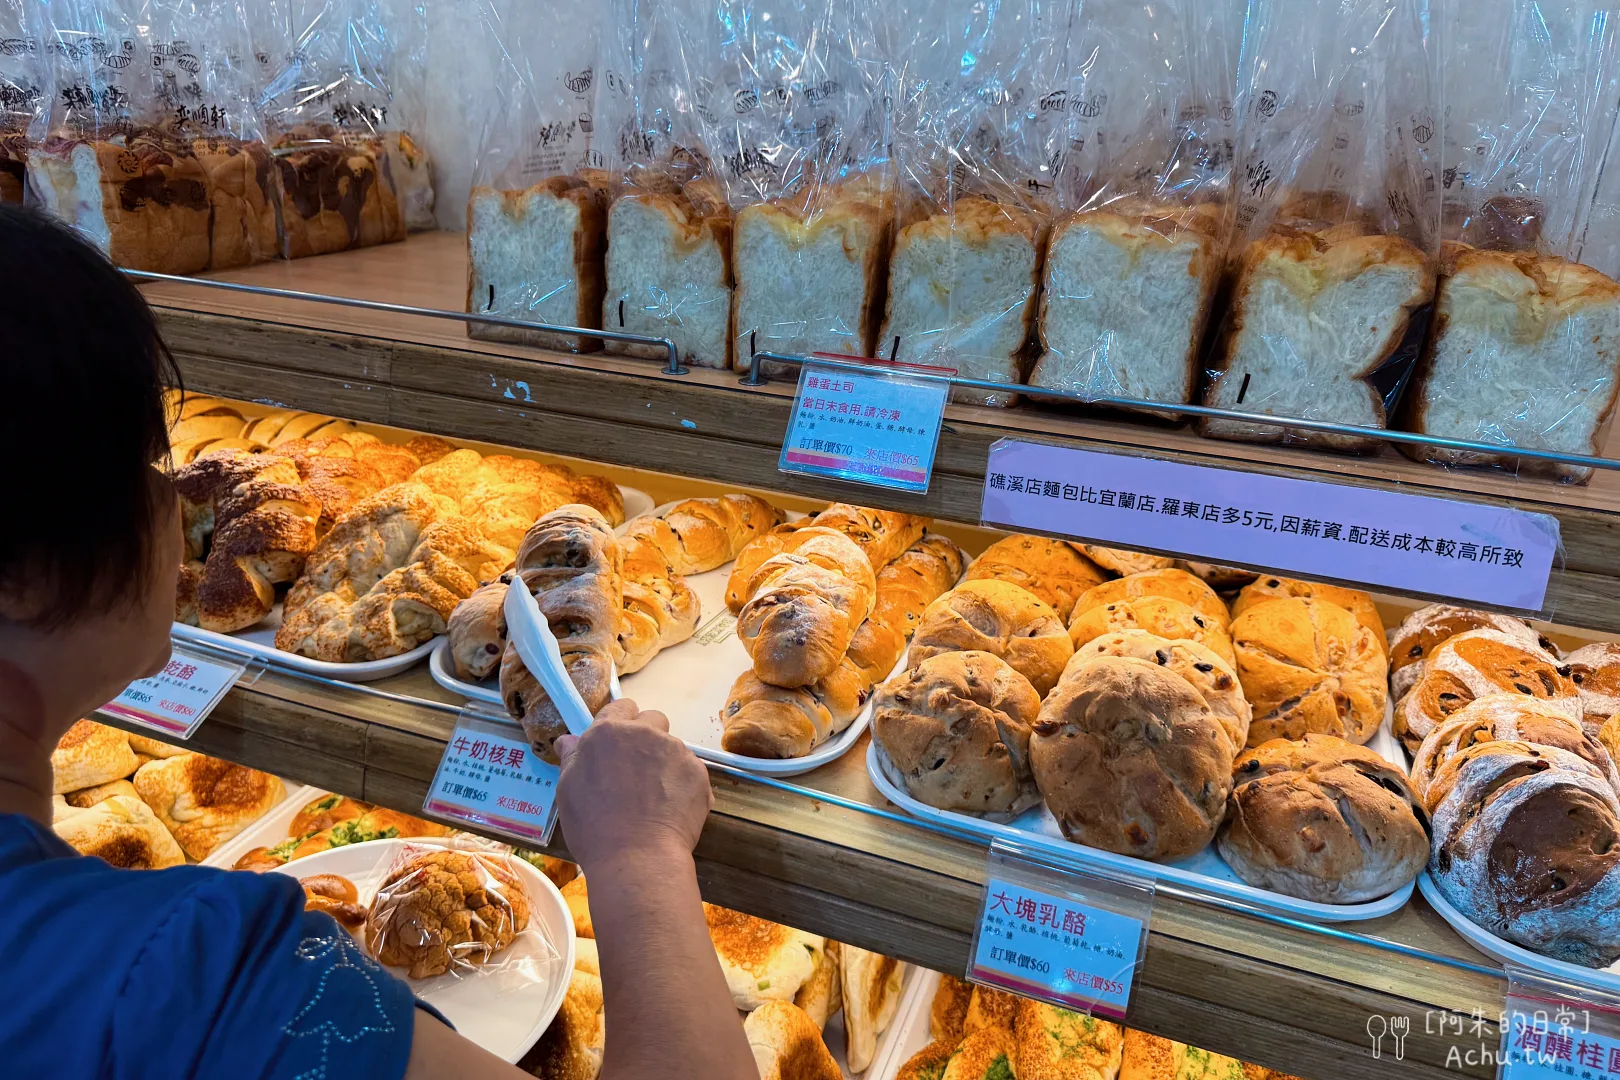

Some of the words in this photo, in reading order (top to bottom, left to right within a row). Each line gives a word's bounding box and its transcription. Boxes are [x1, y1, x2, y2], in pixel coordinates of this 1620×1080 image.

[173, 103, 226, 130] 奕順軒
[806, 376, 855, 394] 雞蛋土司
[799, 437, 853, 456] 訂單價$70
[865, 448, 920, 467] 來店價$65
[452, 736, 525, 769] 牛奶核果
[441, 781, 488, 801] 訂單價$65
[496, 795, 543, 816] 來店價$60
[989, 891, 1087, 936] 大塊乳酪
[989, 946, 1050, 974] 訂單價$60
[1063, 967, 1124, 995] 來店價$55
